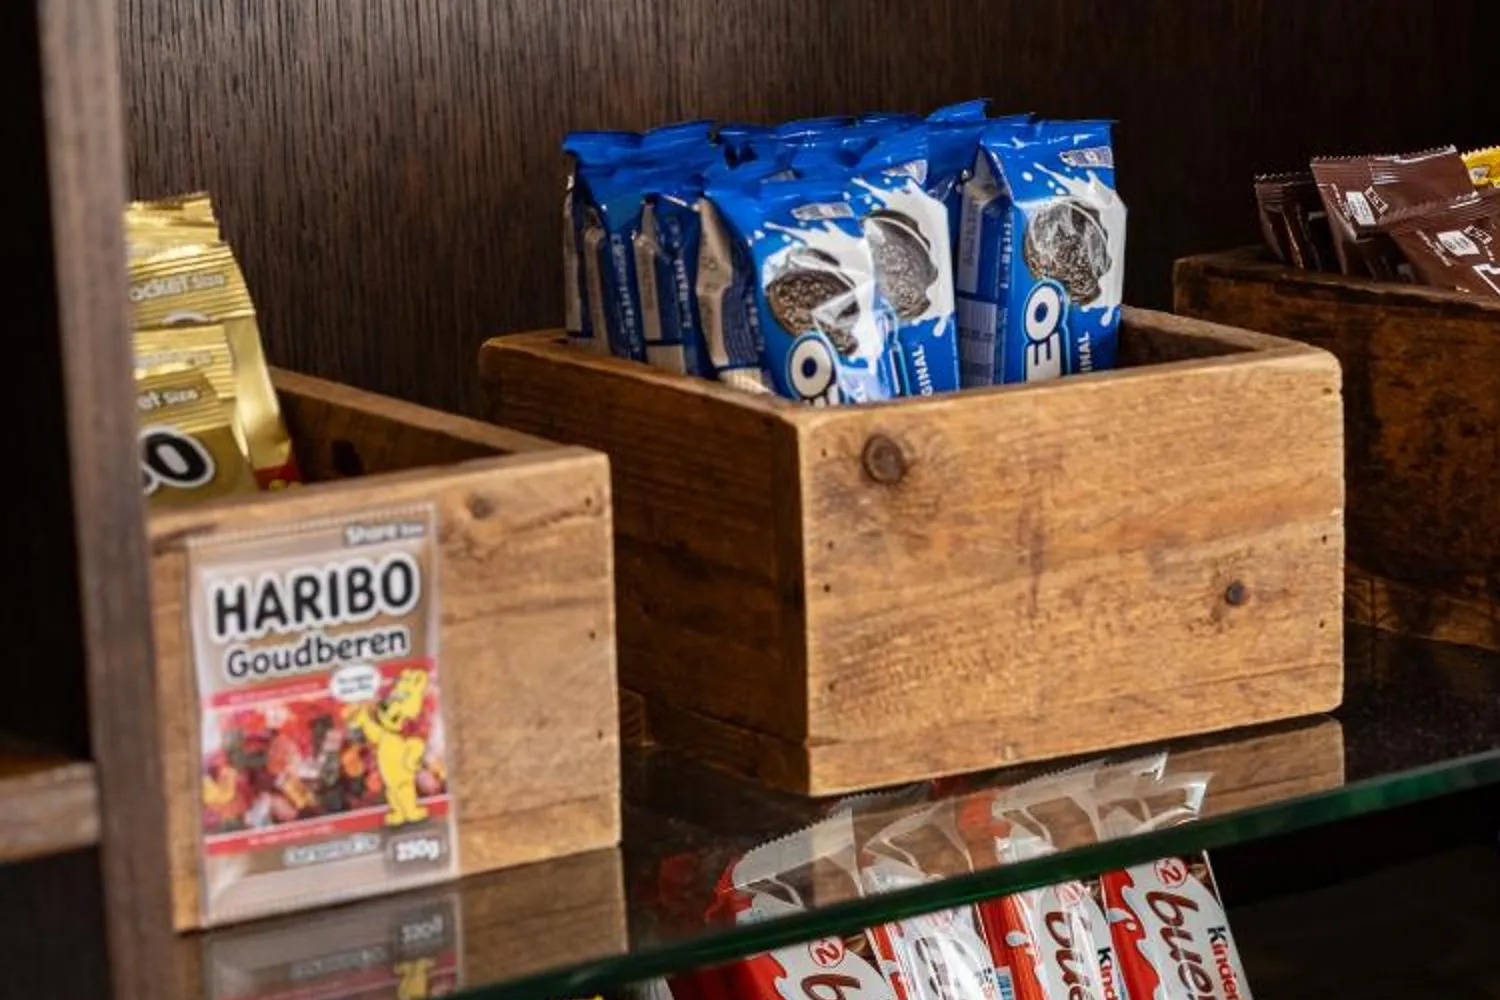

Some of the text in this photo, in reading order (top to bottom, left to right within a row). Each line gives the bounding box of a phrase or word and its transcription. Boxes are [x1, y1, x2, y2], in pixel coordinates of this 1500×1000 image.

[1025, 284, 1061, 382] EO
[912, 343, 933, 396] GINAL
[214, 558, 415, 636] HARIBO
[227, 629, 406, 678] Goudberen
